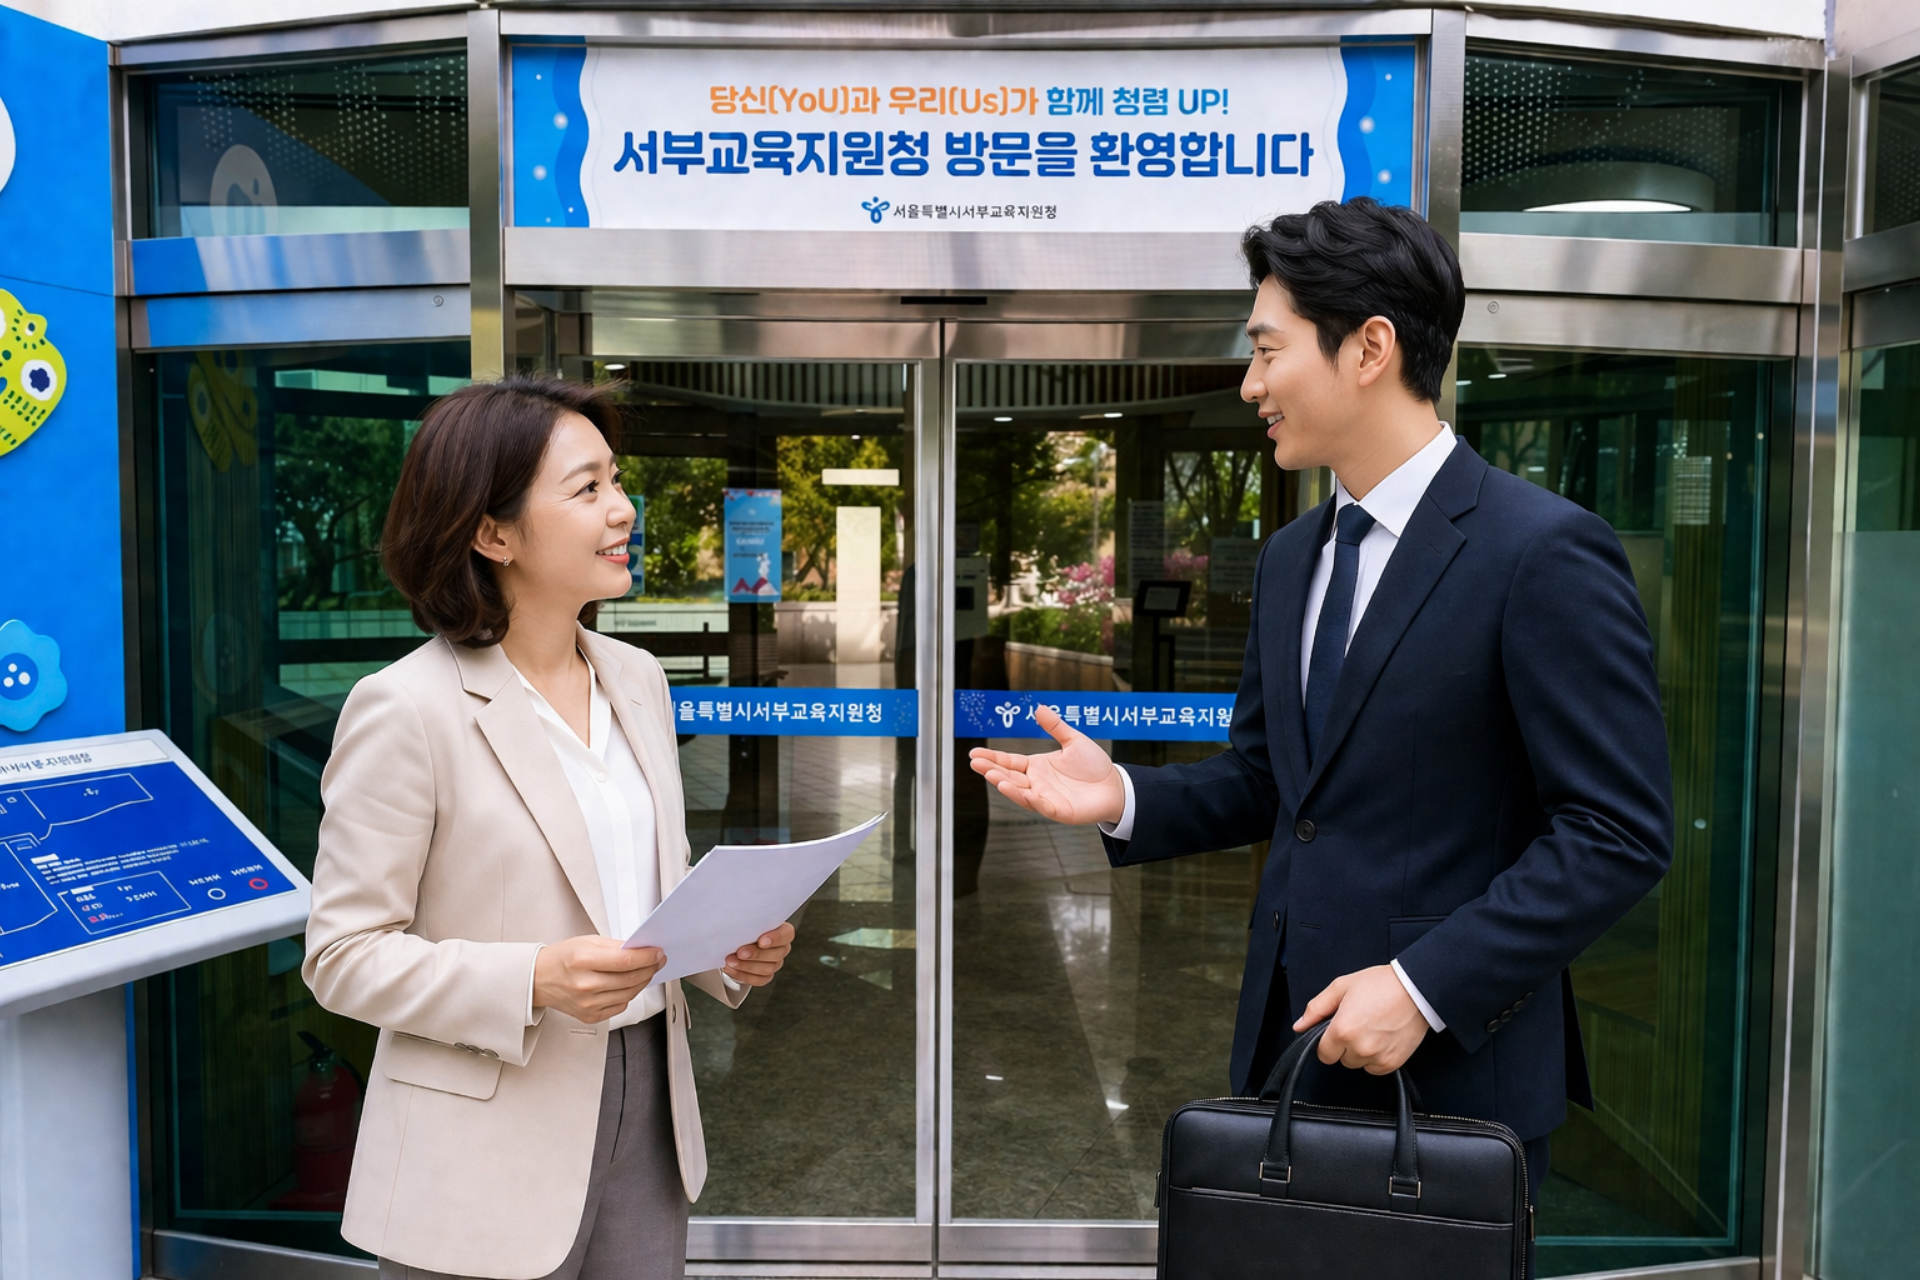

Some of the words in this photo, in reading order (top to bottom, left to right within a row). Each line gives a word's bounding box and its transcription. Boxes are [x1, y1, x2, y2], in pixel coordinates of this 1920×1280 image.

[1046, 86, 1104, 116] 함께
[1112, 86, 1169, 116] 청렴
[1178, 88, 1230, 116] UP!
[613, 130, 930, 176] 서부교육지원청
[945, 131, 1079, 177] 방문을
[1089, 131, 1315, 178] 환영합니다
[893, 203, 1057, 220] 서울특별시서부교육지원청
[674, 700, 882, 723] 울특별시서부교육지원청
